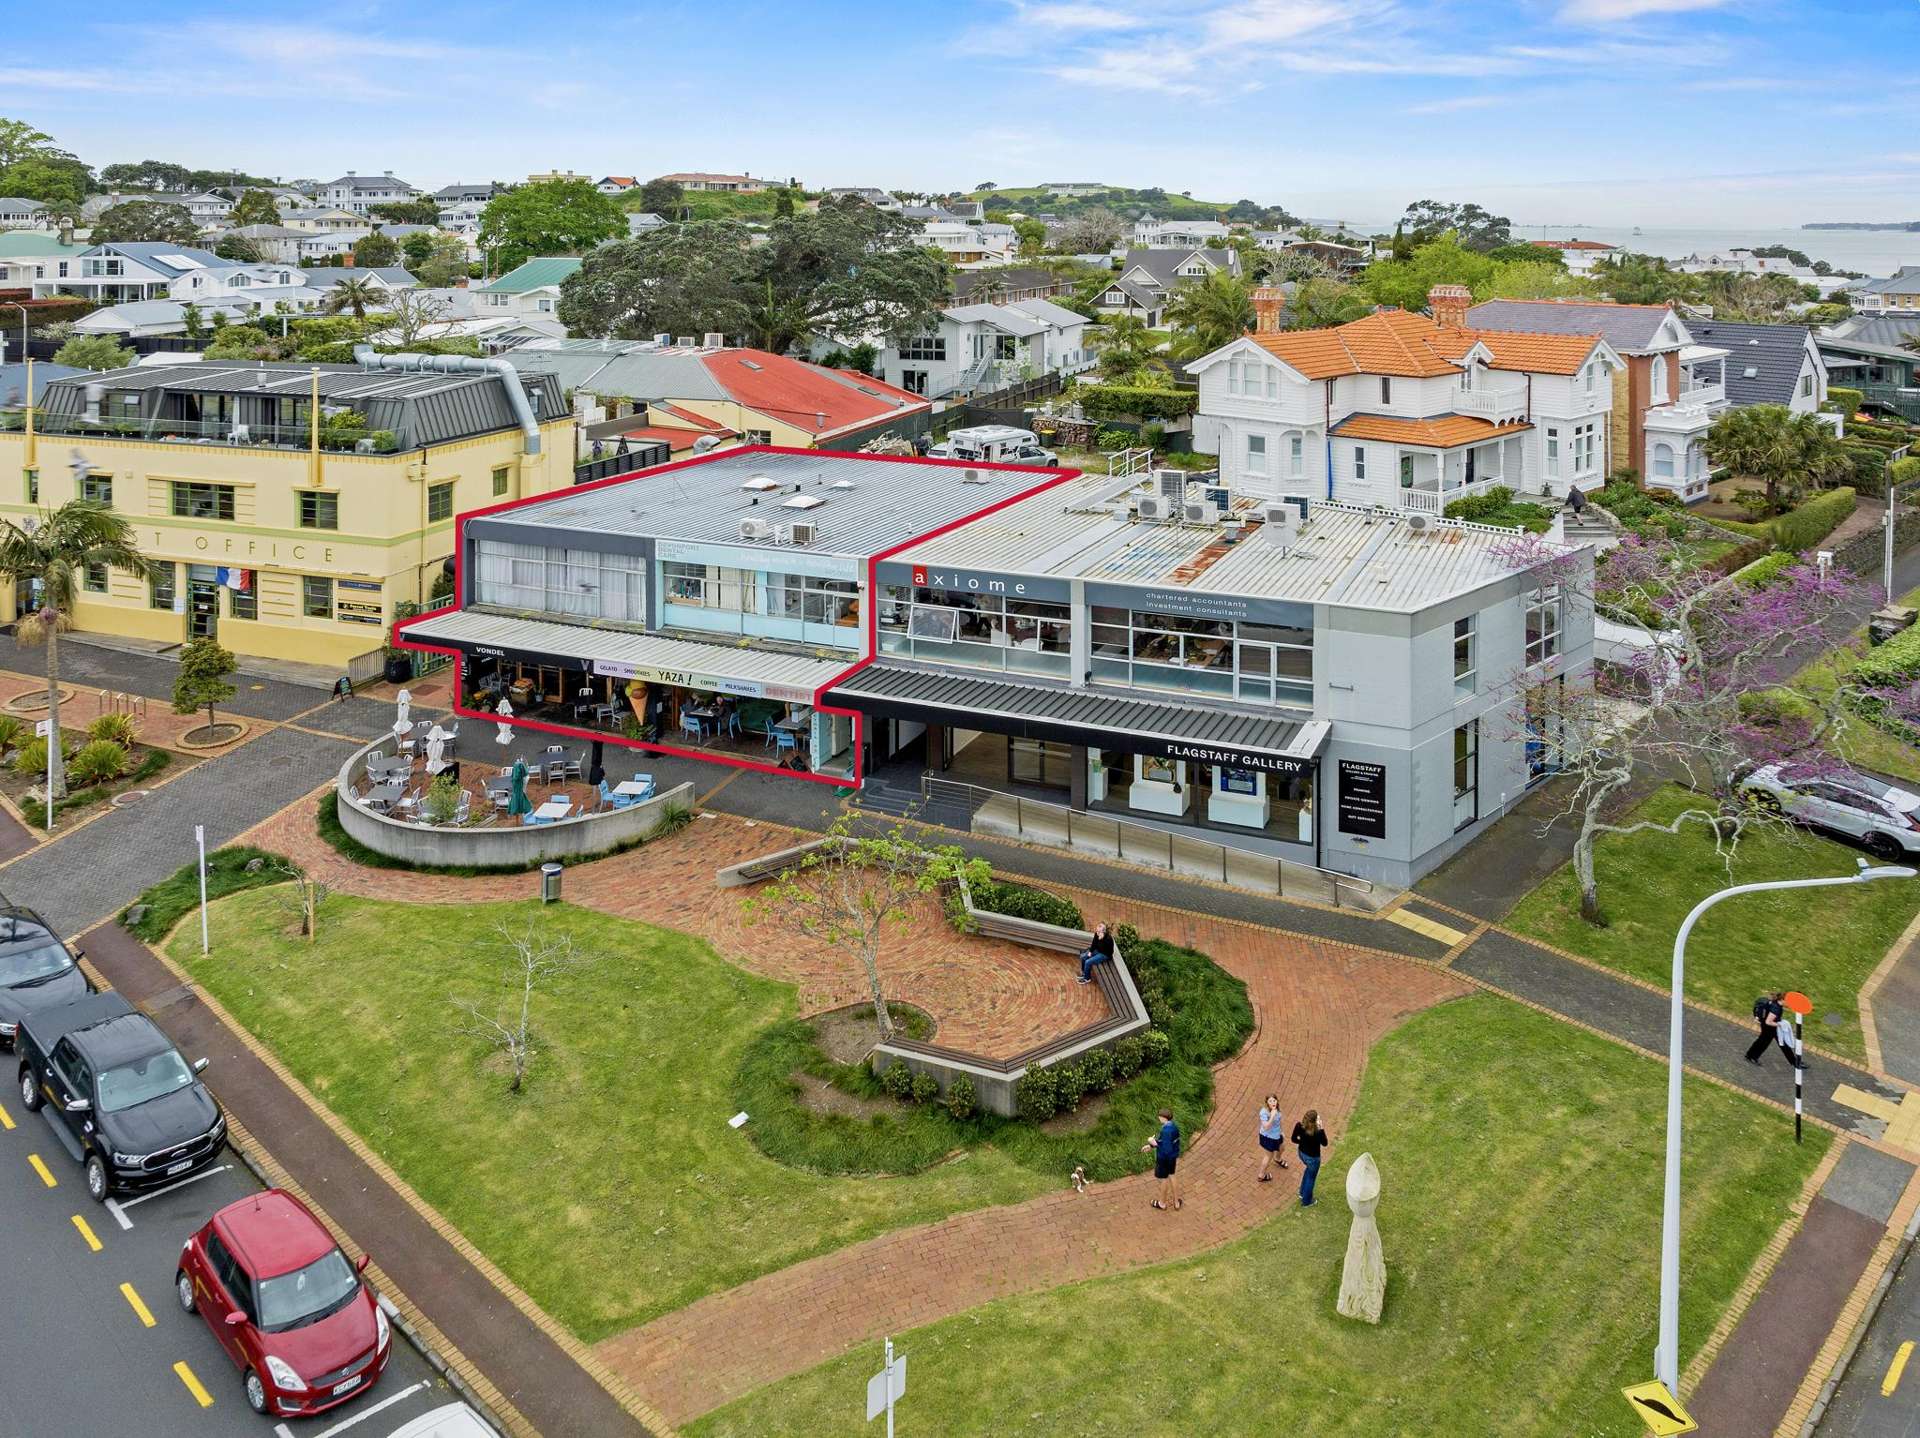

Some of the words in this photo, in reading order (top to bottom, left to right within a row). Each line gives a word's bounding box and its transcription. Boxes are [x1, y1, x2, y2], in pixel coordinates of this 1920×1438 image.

[195, 536, 333, 562] OFFICE
[915, 572, 1025, 594] axiome
[1145, 591, 1188, 602] chartered
[1191, 598, 1247, 608] accountants
[1196, 607, 1247, 617] consultants
[475, 646, 505, 657] VONDEL
[599, 664, 618, 672] GELATO
[700, 679, 718, 687] COFFEE
[724, 683, 757, 693] MILKSHAKES
[1167, 744, 1239, 763] FLAGSTAFF
[1242, 755, 1302, 772] GALLERY
[1342, 762, 1381, 773] FLAGSTAFF
